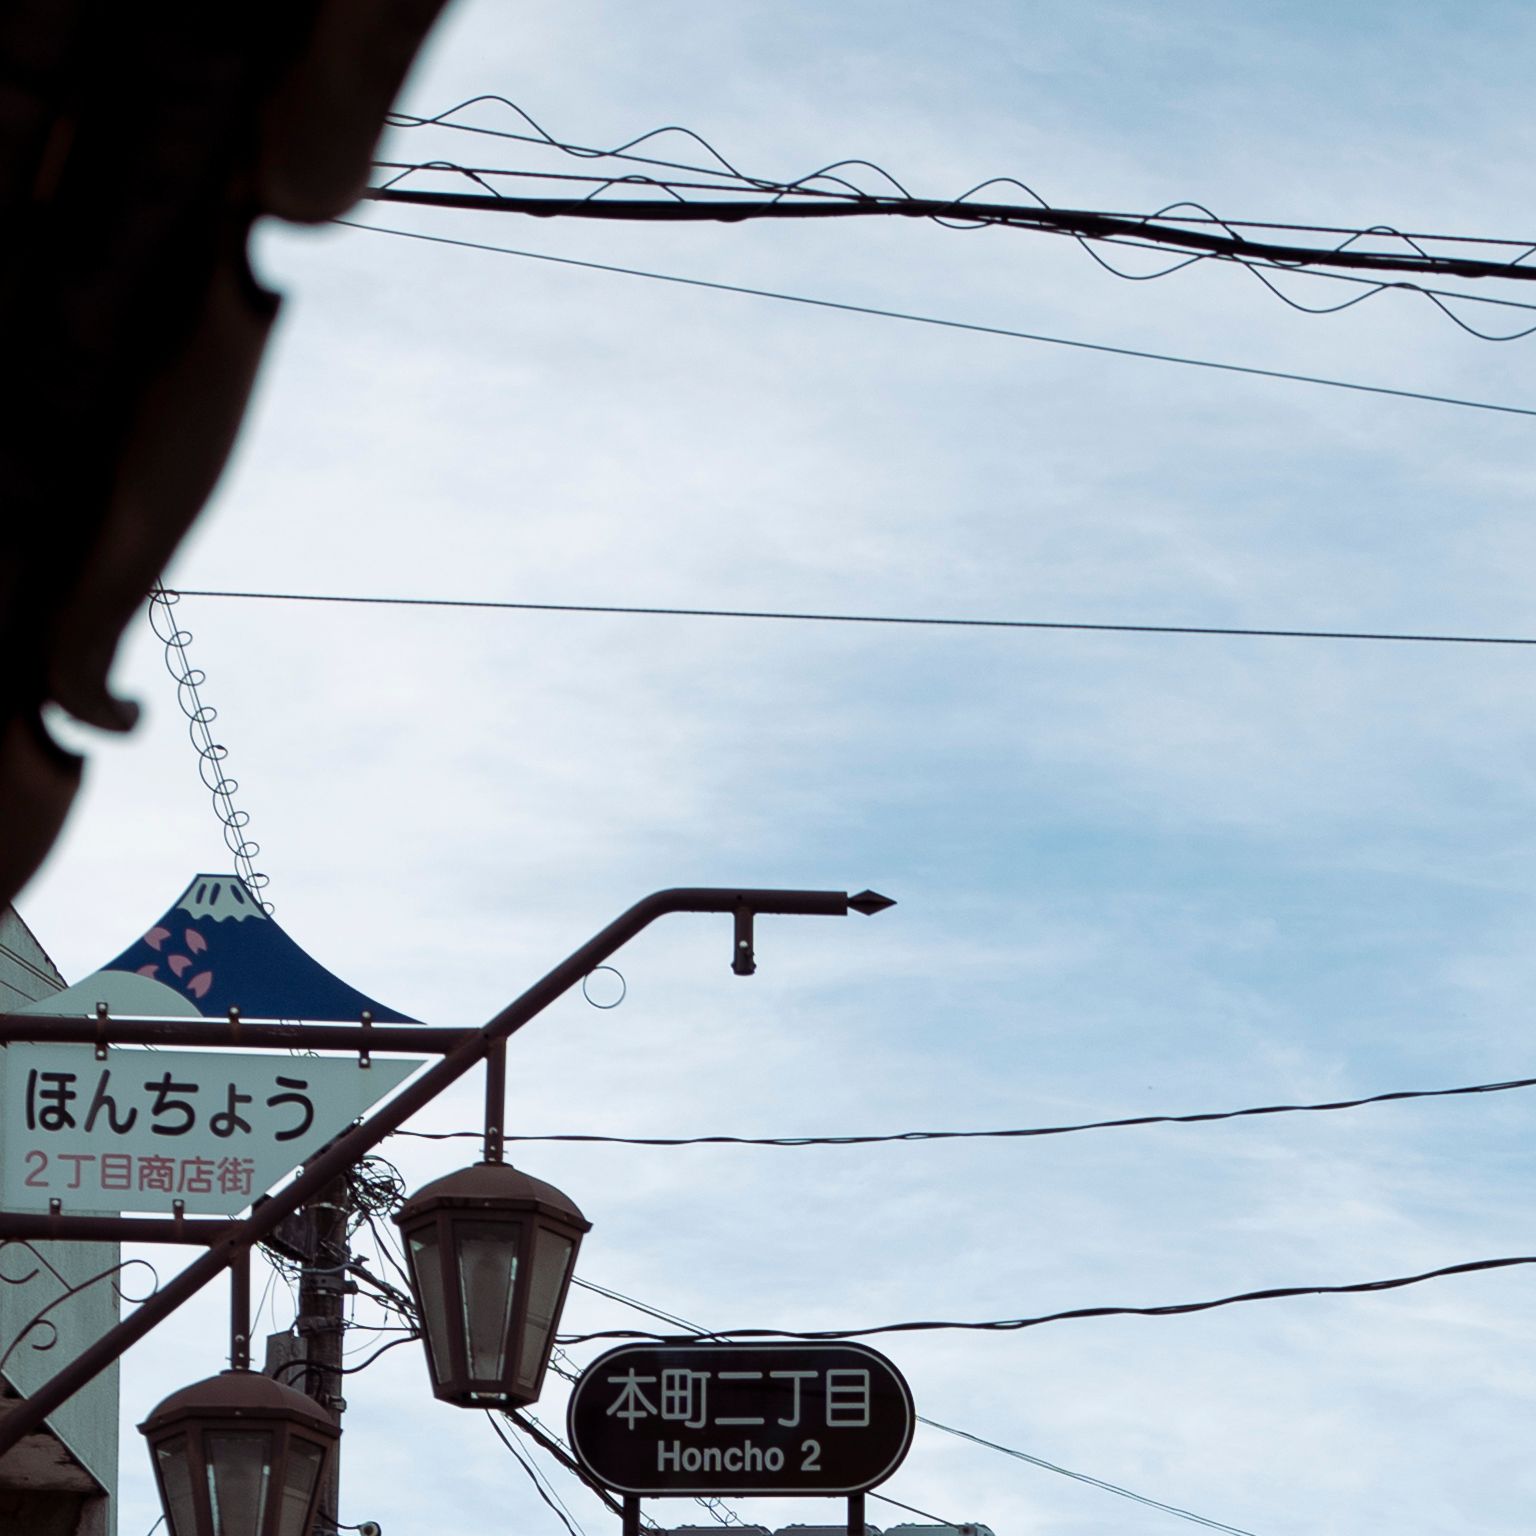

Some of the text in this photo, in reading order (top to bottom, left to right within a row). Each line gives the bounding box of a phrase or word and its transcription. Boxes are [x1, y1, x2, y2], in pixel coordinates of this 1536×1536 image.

[26, 1068, 315, 1141] ほんちょう
[24, 1150, 255, 1195] 2丁目商店街
[605, 1367, 870, 1431] 本町二丁目
[657, 1439, 822, 1472] Honcho 2
